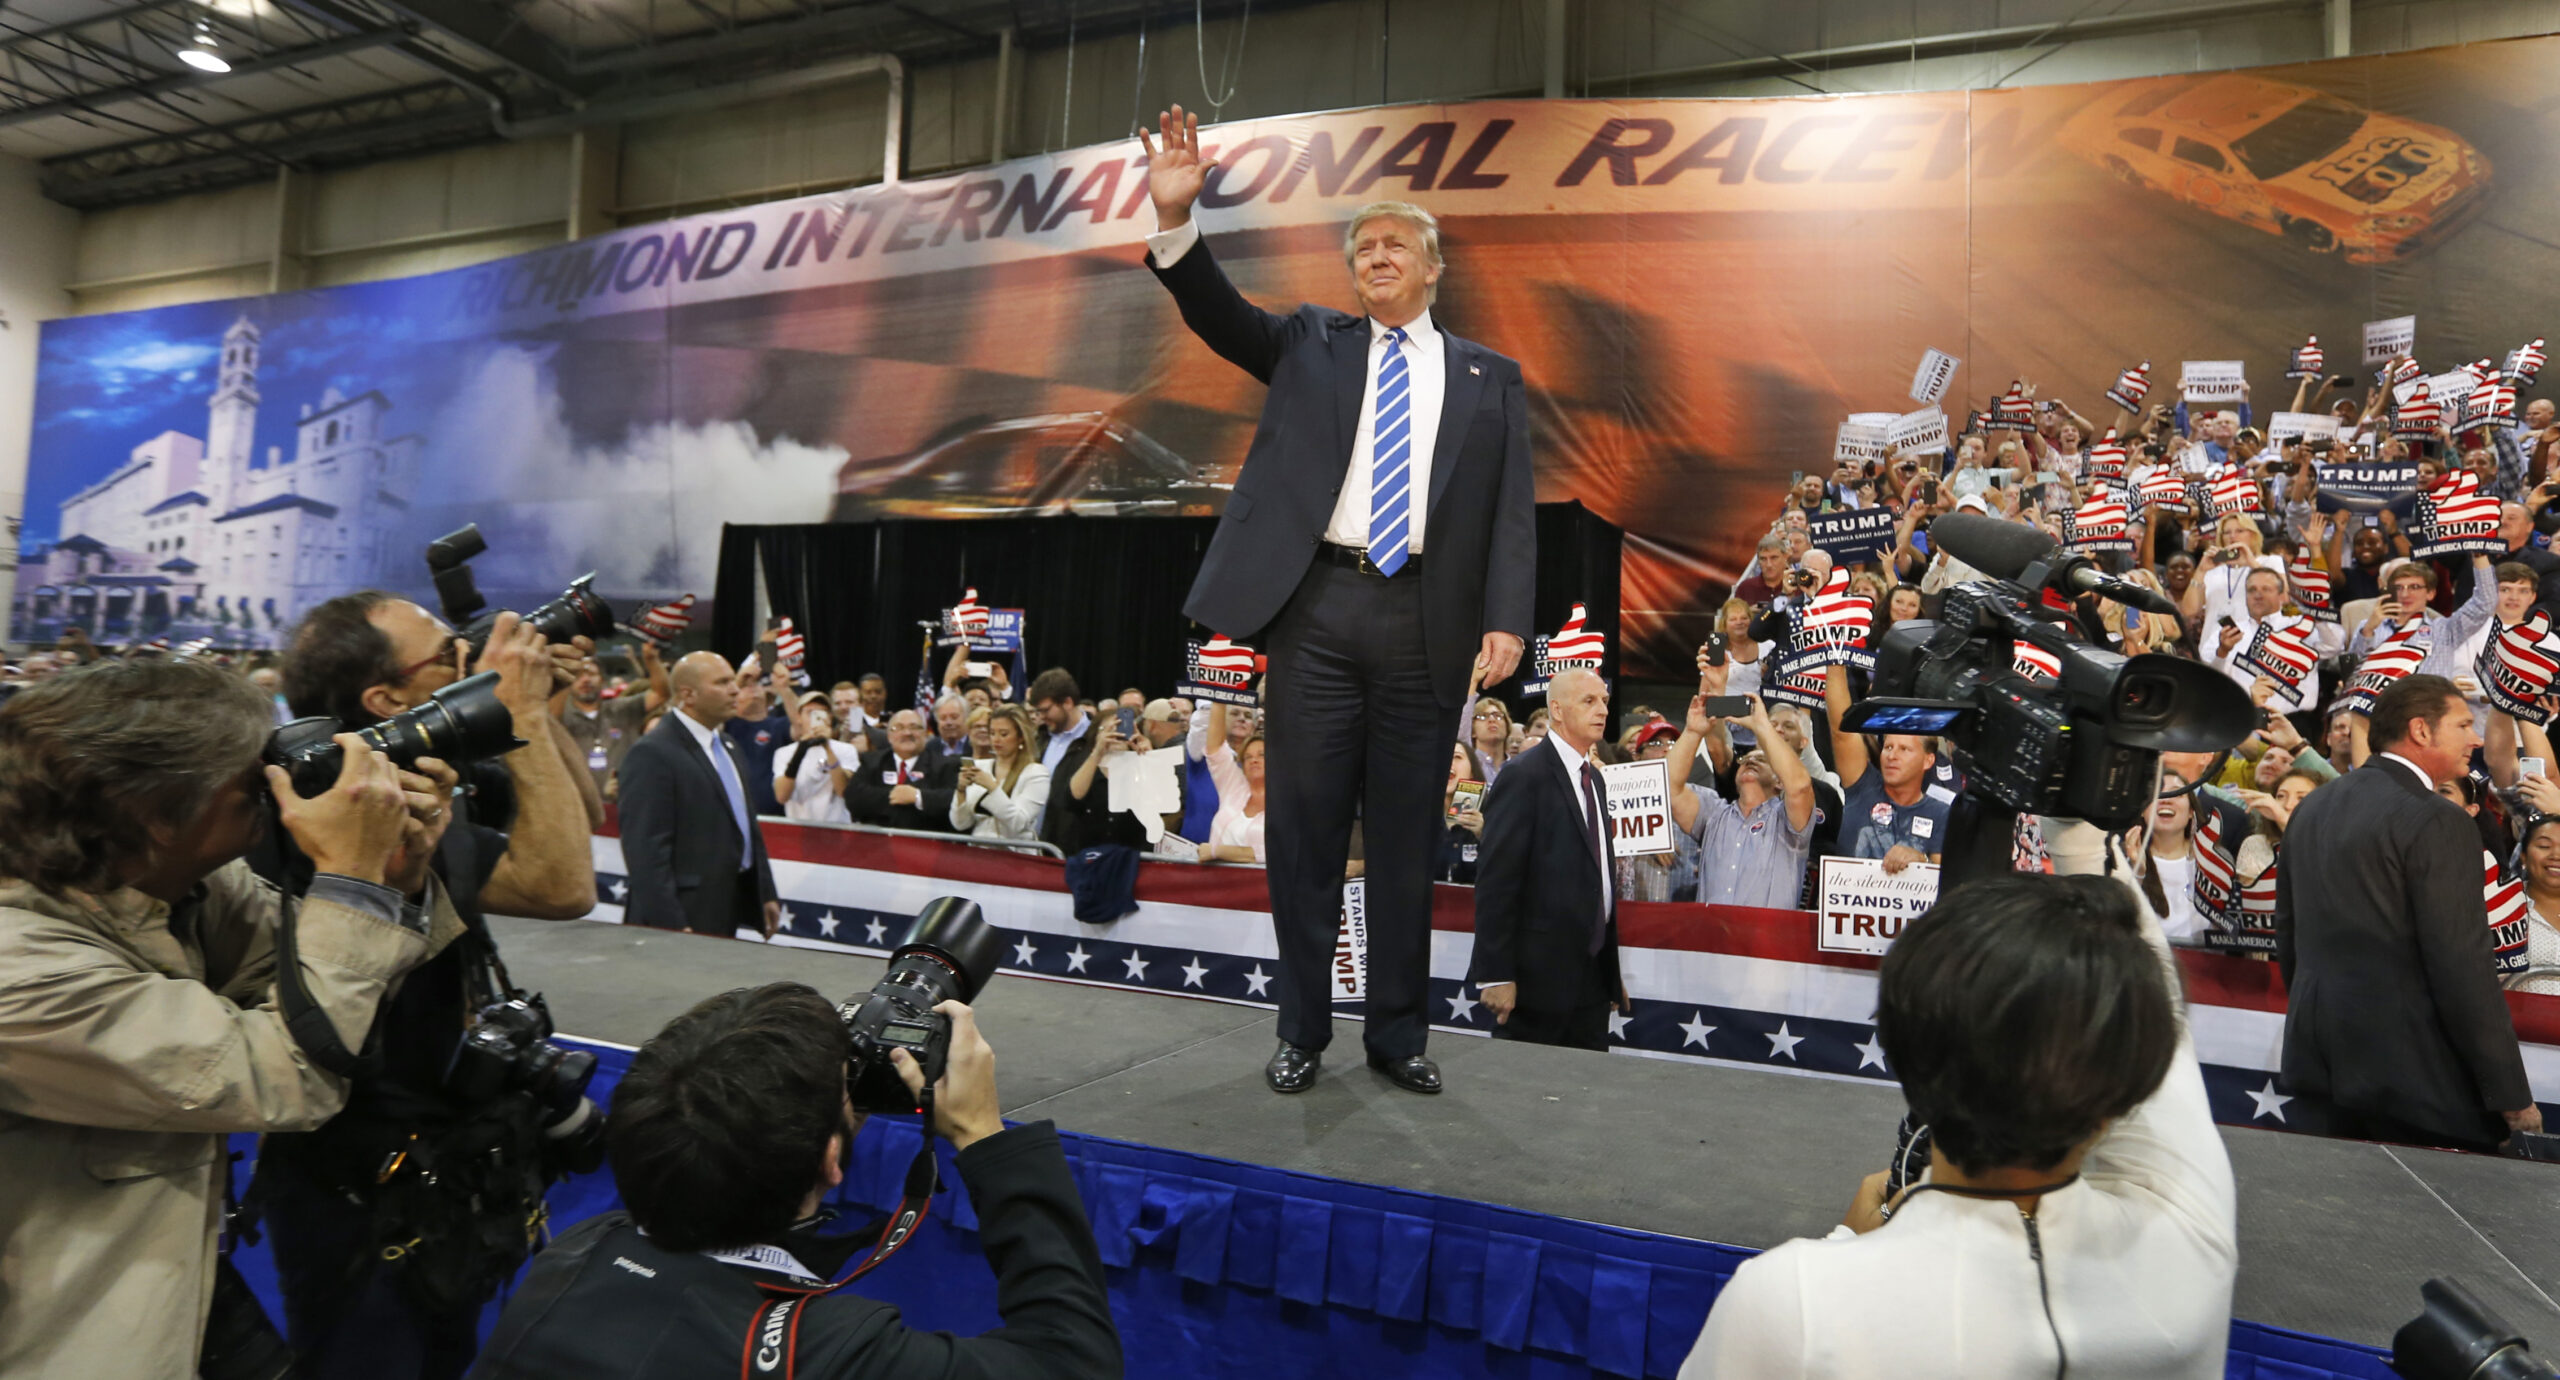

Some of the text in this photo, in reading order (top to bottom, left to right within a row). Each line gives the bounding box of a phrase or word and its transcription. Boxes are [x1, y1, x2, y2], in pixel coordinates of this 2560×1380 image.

[447, 221, 756, 318] RICHMOND
[763, 118, 1515, 270] INTERNATONAL
[2367, 341, 2412, 357] TRUMP
[1925, 357, 1951, 403] TRUMP
[2187, 384, 2241, 394] TRUMP
[2449, 384, 2475, 396] WITH
[1890, 421, 1941, 440] STANDS WITH
[2397, 420, 2434, 429] RUMP
[1893, 429, 1943, 449] TRUMP
[2088, 465, 2119, 474] RUMP
[2321, 468, 2418, 483] TRUMP
[2139, 491, 2178, 506] RUMP
[2204, 498, 2254, 519] TRUMP
[1811, 513, 1892, 535] TRUMP
[2423, 522, 2492, 541] TRUMP
[1829, 535, 1854, 543] AMERICA
[1854, 532, 1873, 540] GREAT
[2065, 525, 2120, 543] TRUMP
[2073, 542, 2096, 553] AMECA
[2413, 546, 2433, 558] MAKE
[2433, 542, 2462, 553] AMERICA
[2462, 541, 2484, 550] GREAT
[988, 613, 1015, 628] UMP
[1790, 626, 1862, 652] TRUMP
[1781, 662, 1800, 675] MAKE
[1799, 650, 1827, 669] AMERICA
[1827, 649, 1851, 661] GRAT
[1850, 650, 1876, 668] AGAIN!
[2250, 643, 2298, 679] TRUMP
[1187, 665, 1244, 687] TRUMP
[1192, 687, 1215, 698] AMERICA
[1214, 690, 1234, 700] GREAT
[1523, 683, 1542, 694] MAKE
[1763, 688, 1777, 697] MAKE
[1777, 693, 1800, 702] AMERICA
[1800, 696, 1819, 706] GREAT
[2510, 703, 2543, 721] AGAIN!
[1609, 776, 1658, 796] majority
[1622, 795, 1663, 810] WITH
[1611, 813, 1664, 840] UMP
[1829, 871, 1938, 896] the silent major
[1828, 893, 1904, 910] STANDS
[1350, 886, 1367, 948] STANDS
[1828, 911, 1917, 939] TRU
[2209, 909, 2234, 933] AGAIN!
[2225, 910, 2276, 930] TRU
[2237, 936, 2278, 948] AMERICA
[2491, 918, 2528, 948] UMP
[2508, 953, 2529, 968] GRE
[612, 1256, 657, 1279] patagonia
[760, 1247, 793, 1270] HILL
[756, 1300, 797, 1372] Canon
